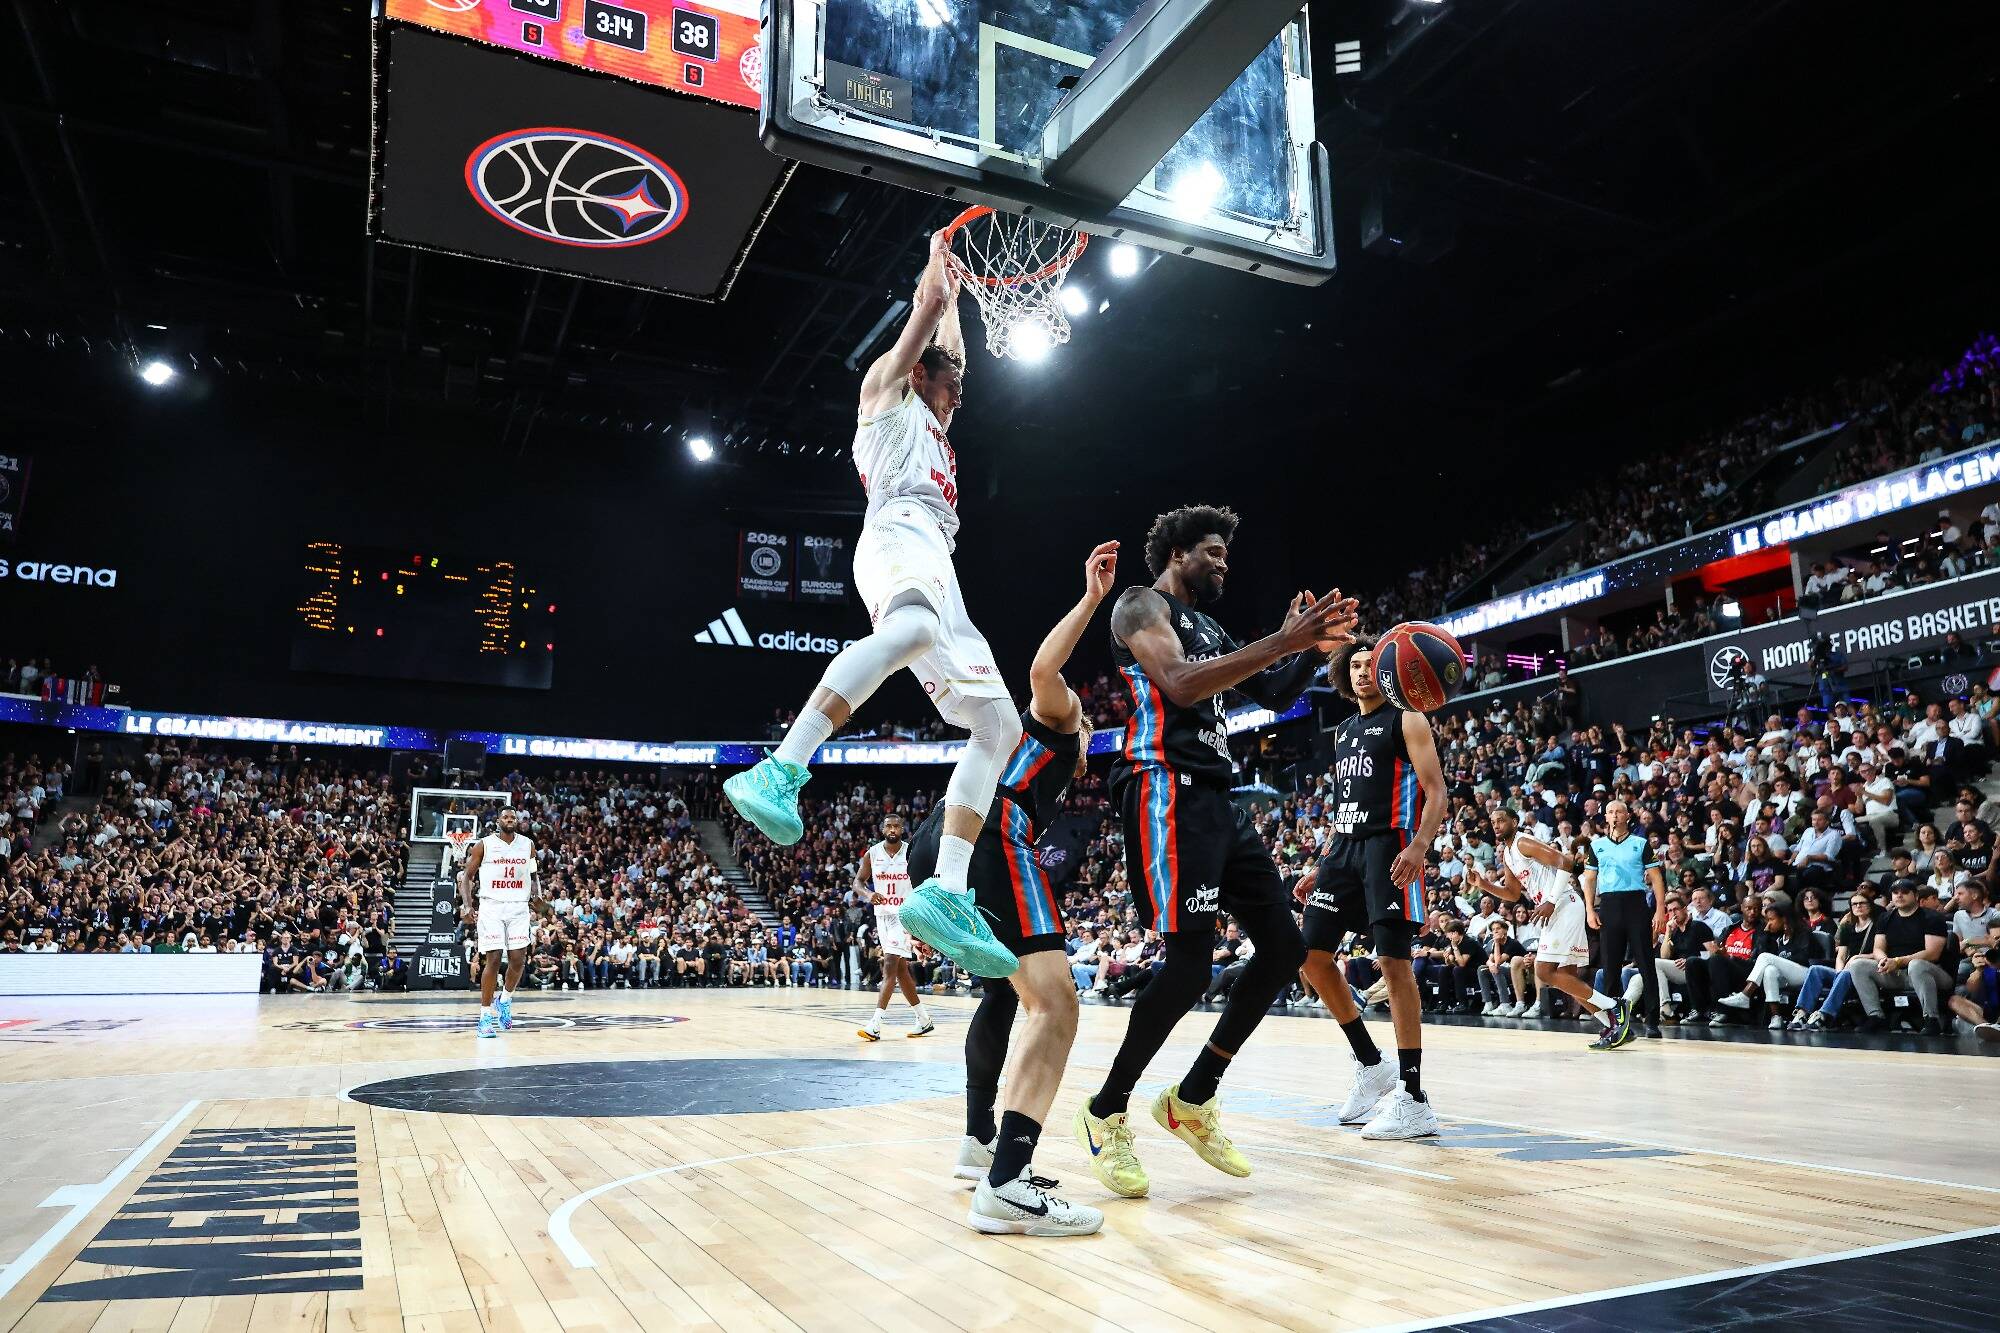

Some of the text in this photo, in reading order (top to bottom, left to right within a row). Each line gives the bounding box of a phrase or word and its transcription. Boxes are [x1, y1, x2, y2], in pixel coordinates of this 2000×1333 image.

[596, 11, 634, 40] 3:14
[528, 26, 538, 41] 5
[679, 21, 709, 49] 38
[1732, 527, 1761, 555] LE
[1763, 500, 1852, 546] GRAND
[747, 532, 787, 546] 2024
[803, 535, 843, 549] 2024
[16, 561, 117, 588] arena
[740, 577, 789, 588] LEADERS CUP
[743, 583, 786, 593] CHAMPIONS
[801, 580, 844, 588] EUROCUP
[758, 631, 838, 654] adidas
[1844, 619, 1904, 653] PARIS
[126, 716, 152, 733] LE
[156, 717, 233, 738] GRAND
[505, 739, 527, 754] LE
[529, 740, 593, 759] GRAND
[822, 748, 843, 763] LE
[1336, 745, 1373, 783] PARIS
[1342, 778, 1351, 799] 3
[493, 857, 526, 865] MONACO
[503, 866, 515, 878] 14
[876, 872, 909, 880] MONACO
[491, 880, 523, 889] FEDCOM
[887, 883, 896, 895] 11
[37, 1125, 364, 1303] MENNEN
